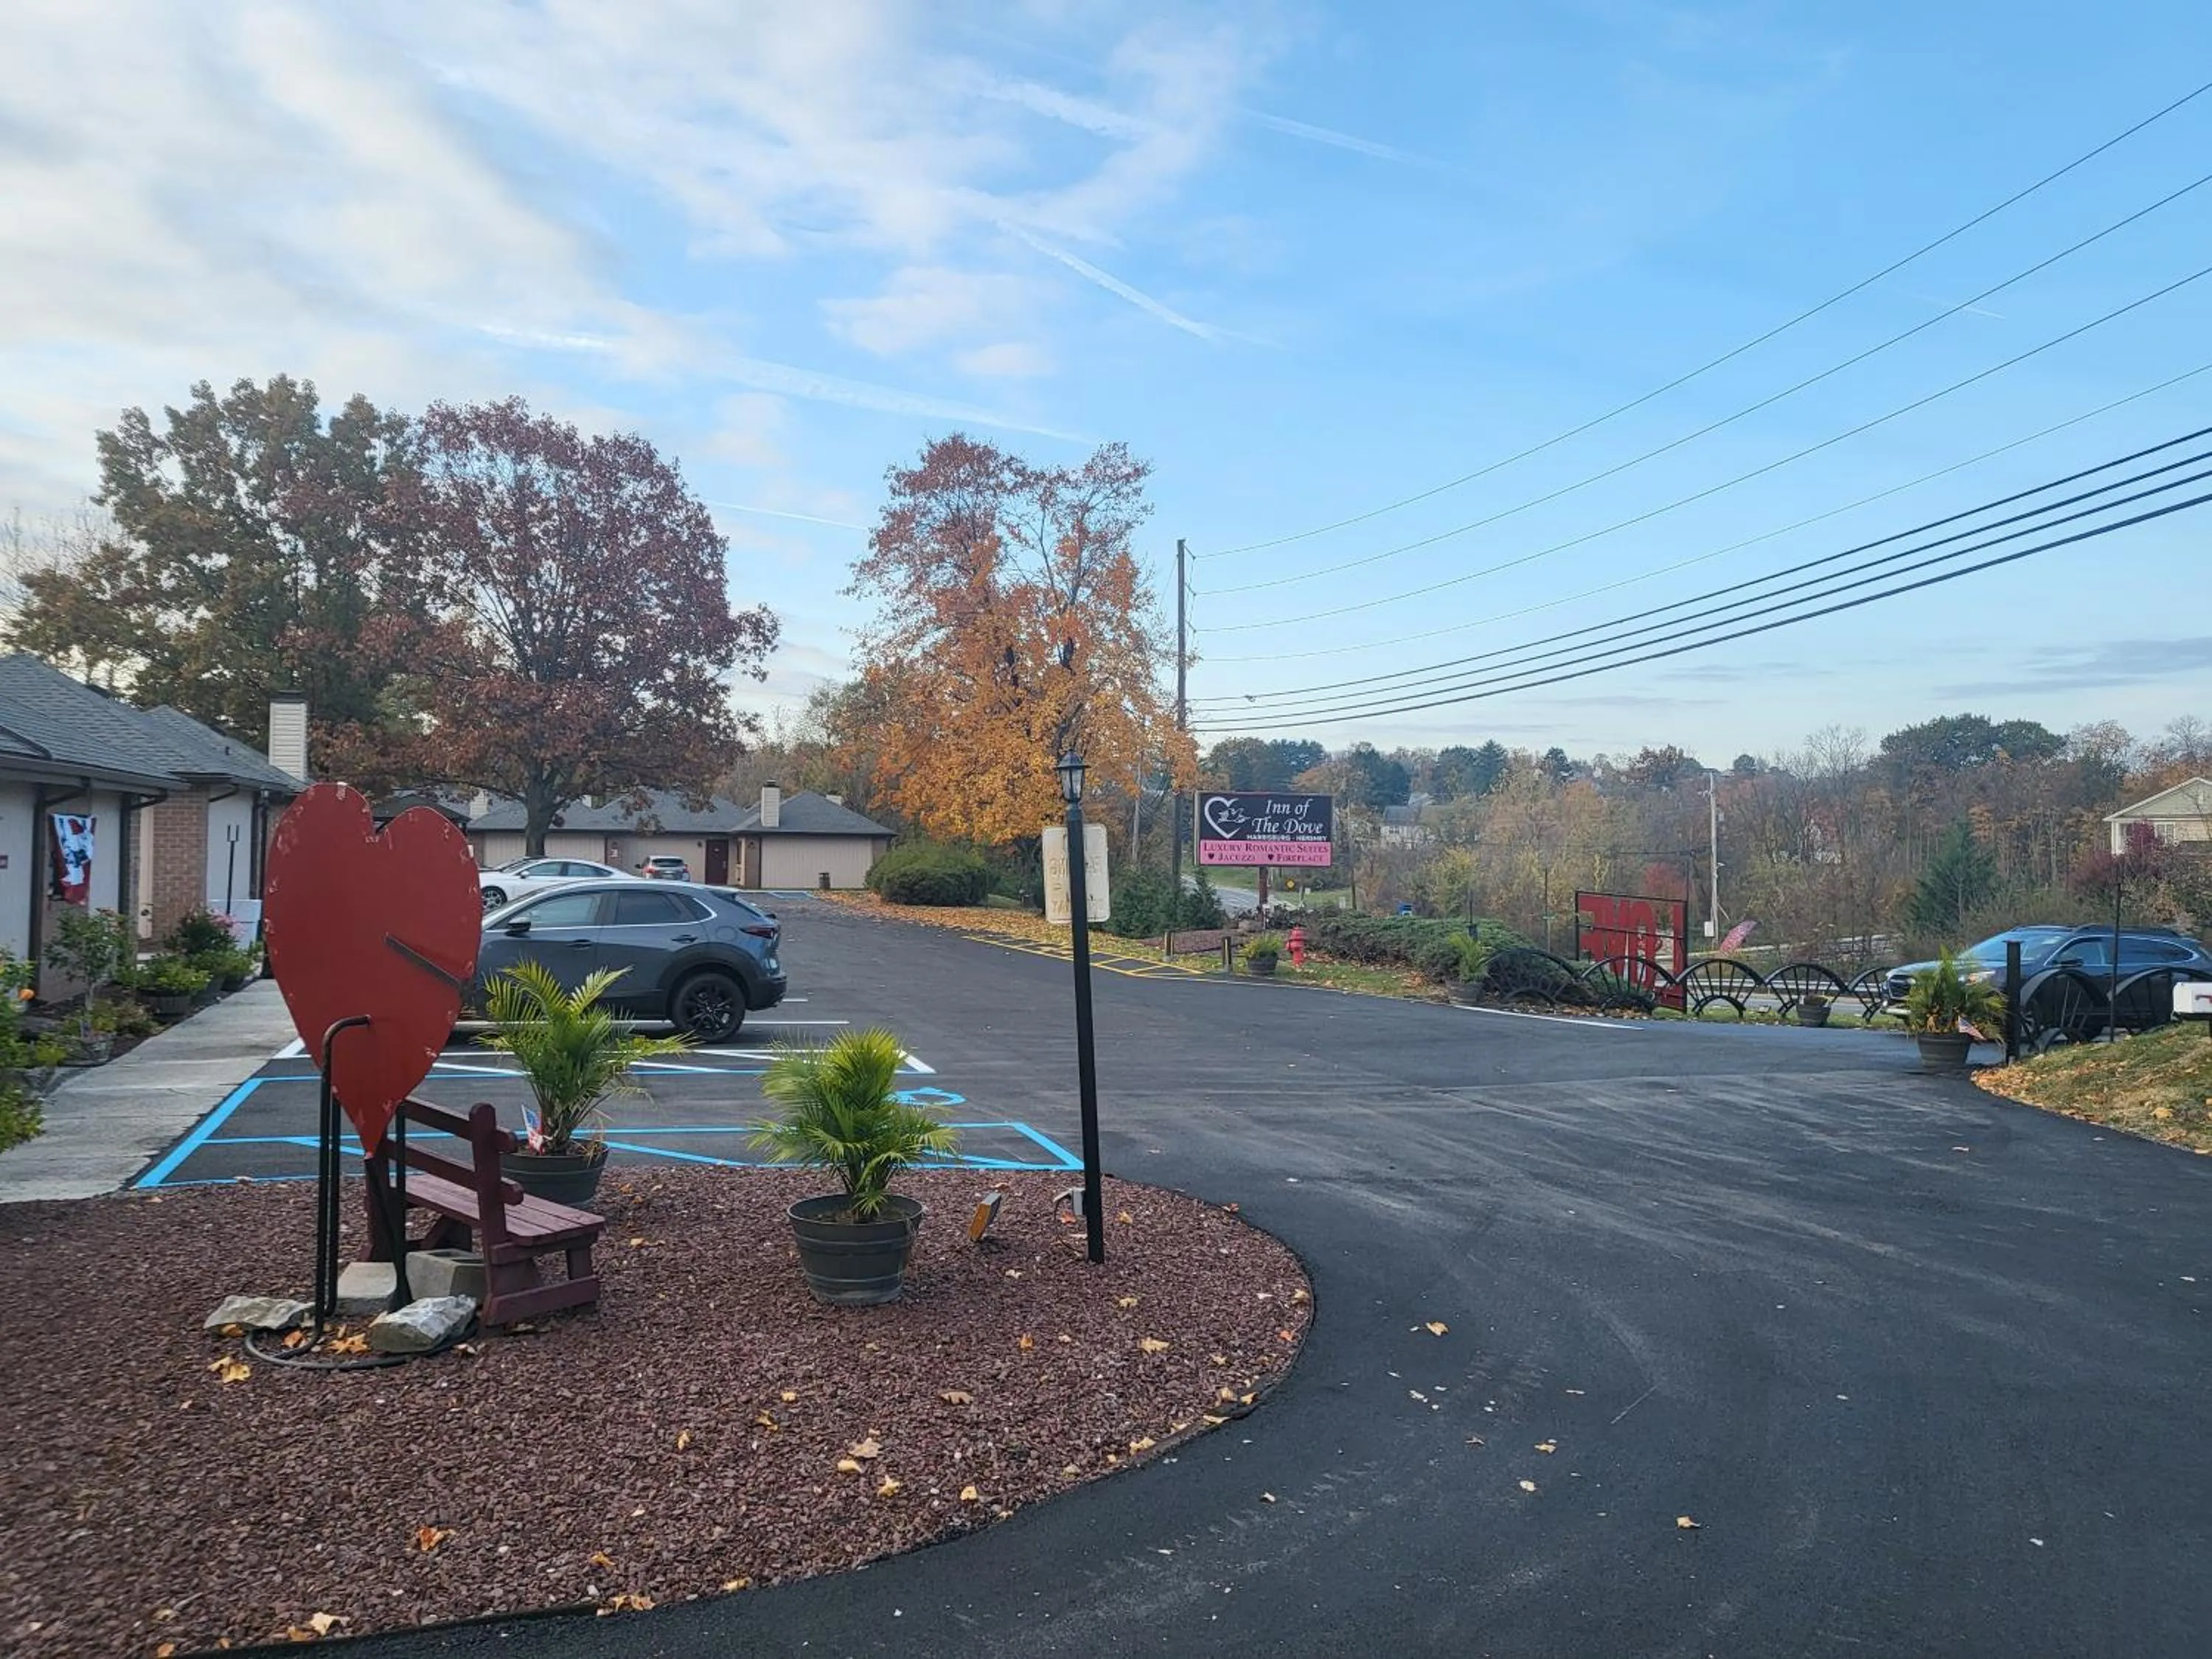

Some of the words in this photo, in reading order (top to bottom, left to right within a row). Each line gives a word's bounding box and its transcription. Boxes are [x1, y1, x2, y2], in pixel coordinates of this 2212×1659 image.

[1265, 799, 1290, 815] Inn
[1295, 798, 1313, 820] of
[1252, 815, 1279, 833] The
[1282, 818, 1324, 834] Dove
[1204, 842, 1242, 852] LUXURY
[1245, 843, 1295, 852] ROMANTIC
[1297, 844, 1329, 853] SUITES
